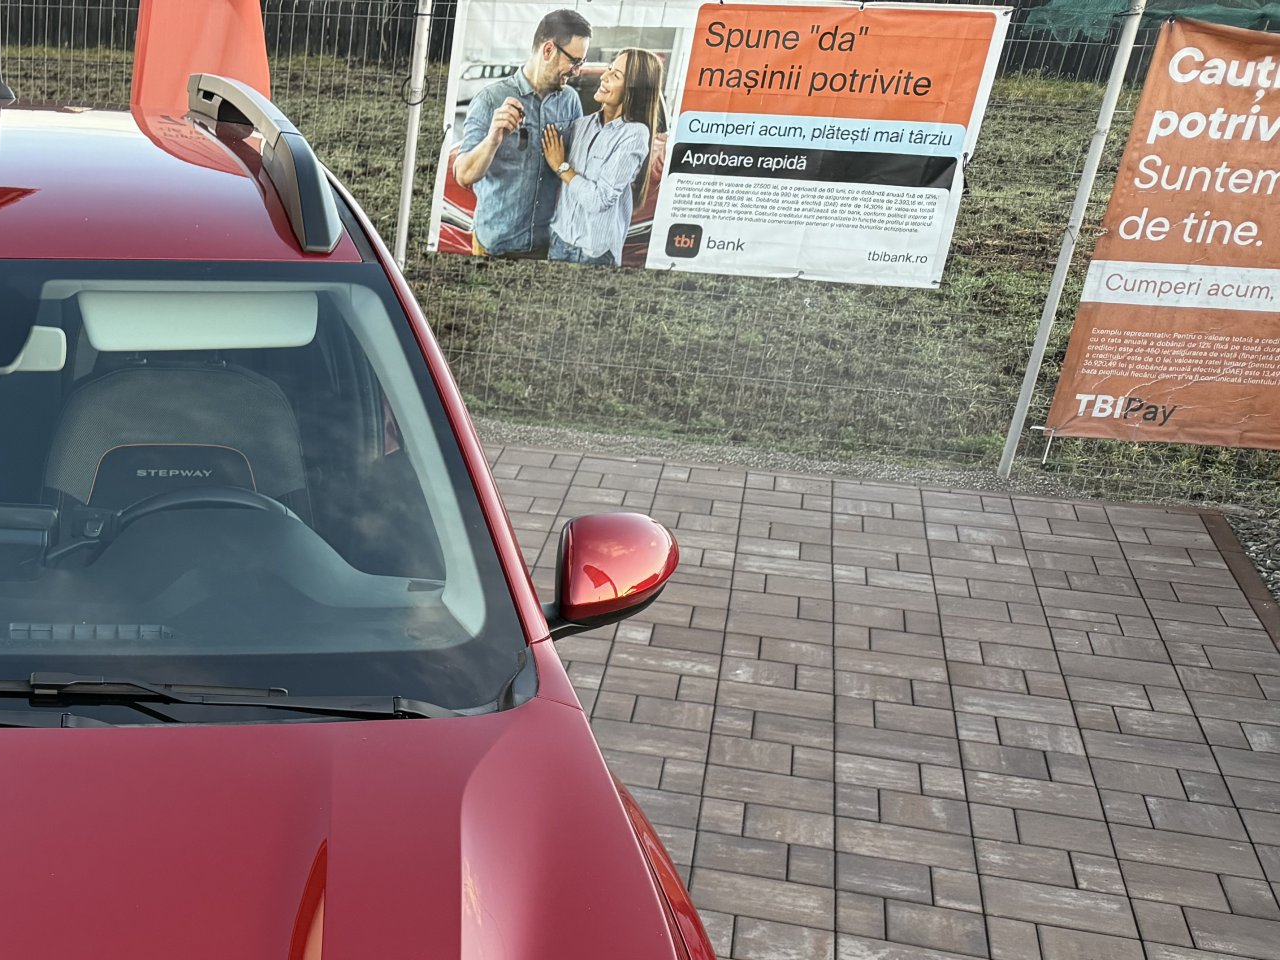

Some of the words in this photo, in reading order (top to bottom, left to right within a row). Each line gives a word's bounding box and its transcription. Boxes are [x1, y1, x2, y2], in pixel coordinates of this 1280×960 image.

[705, 21, 801, 53] Spune
[810, 25, 871, 53] "da"
[697, 64, 802, 95] mașinii
[808, 68, 933, 97] potrivite
[688, 118, 756, 138] Cumperi
[758, 123, 807, 141] acum,
[810, 125, 870, 145] plătești
[873, 127, 904, 144] mai
[907, 129, 953, 147] târziu
[681, 149, 754, 169] Aprobare
[757, 154, 807, 173] rapidă
[1118, 207, 1170, 242] de
[1183, 210, 1264, 247] tine.
[673, 234, 696, 249] tbi
[707, 236, 745, 252] bank
[867, 251, 929, 265] tbibank.ro
[1105, 273, 1203, 299] Cumperi
[1207, 281, 1275, 302] acum,
[1091, 327, 1122, 336] Exemplu
[1075, 393, 1177, 426] TBIPay
[136, 469, 213, 477] STEPWAY
